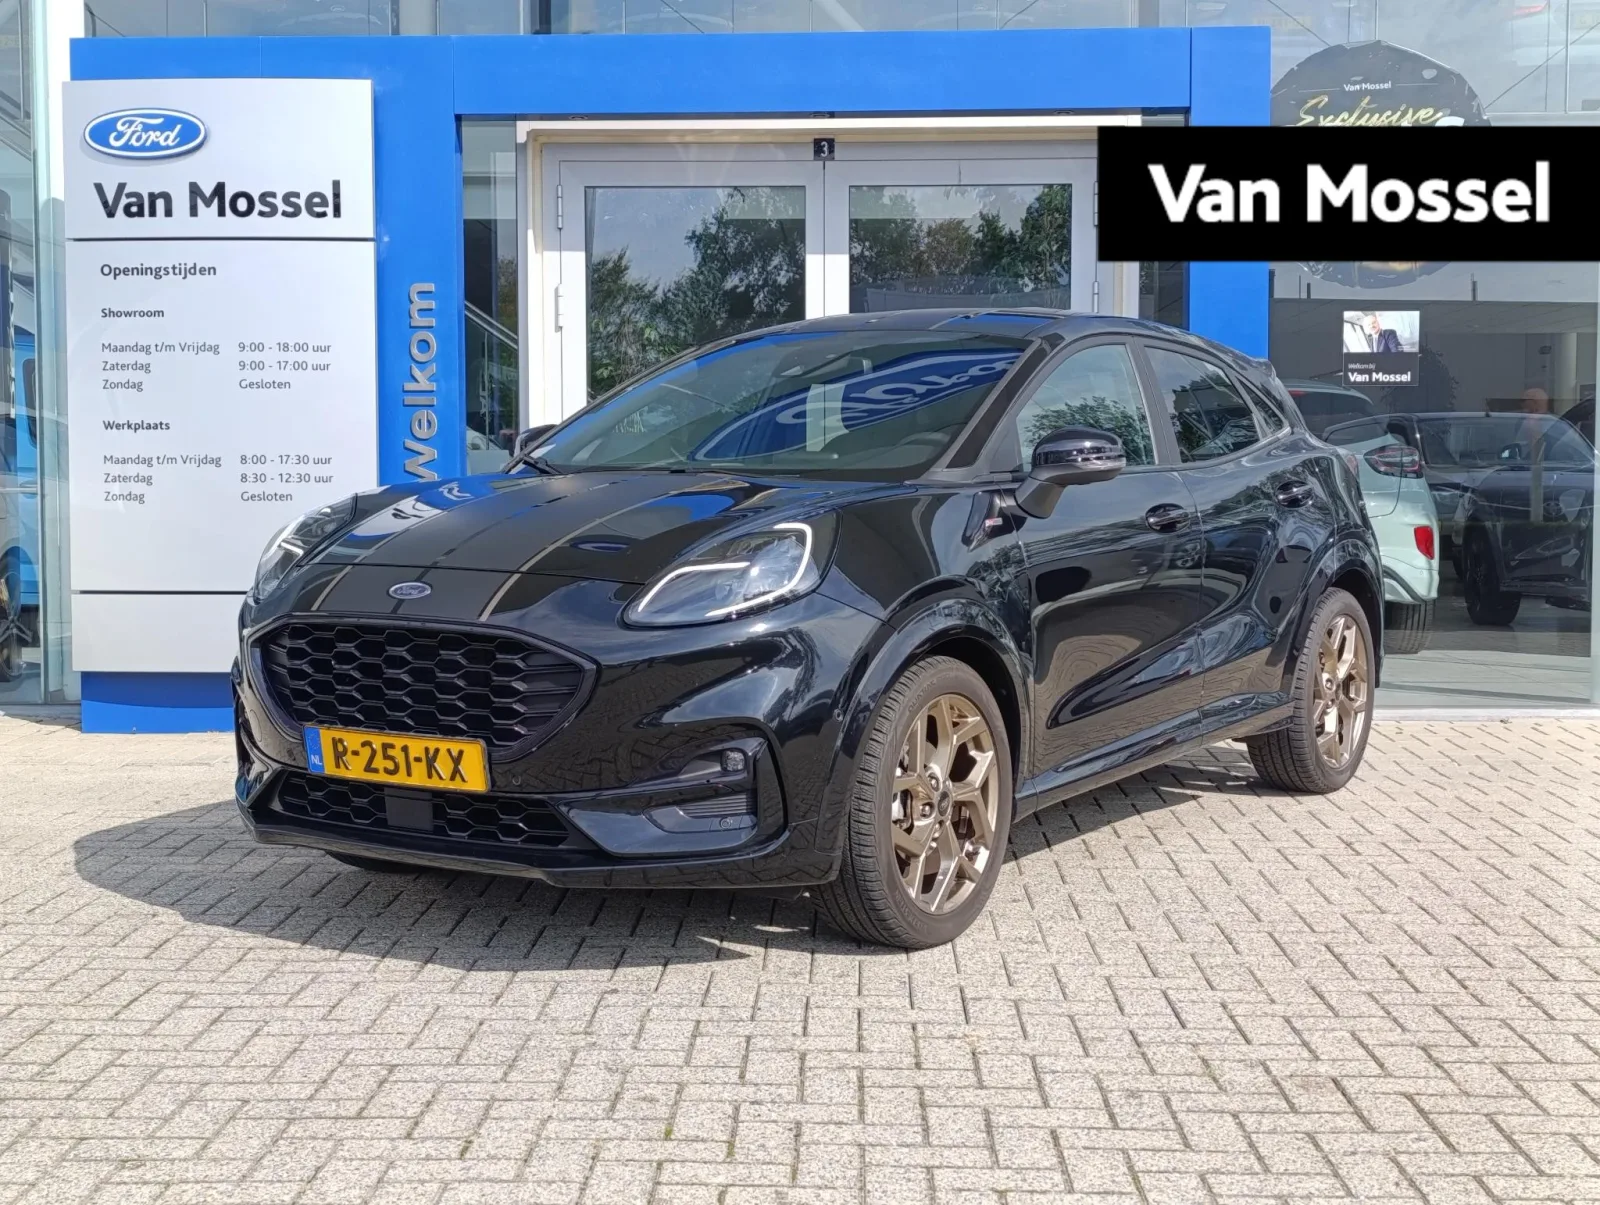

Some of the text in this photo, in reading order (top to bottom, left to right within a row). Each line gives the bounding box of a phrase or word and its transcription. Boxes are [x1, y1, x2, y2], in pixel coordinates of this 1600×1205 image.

[1343, 80, 1392, 92] Van Mossel
[108, 116, 182, 147] Ford
[819, 140, 829, 158] 3
[93, 179, 342, 219] Van Mossel
[100, 262, 217, 281] Openingstijden
[100, 307, 165, 319] Showroom
[101, 341, 152, 356] Maandag
[154, 341, 176, 353] t/m
[178, 341, 221, 356] Vrijdag
[237, 341, 265, 353] 9:00
[276, 341, 310, 353] 18:00
[312, 344, 332, 353] uur
[102, 360, 152, 374] Zaterdag
[238, 360, 265, 371] 9:00
[276, 360, 309, 371] 17:00
[311, 363, 331, 372] uur
[403, 282, 438, 482] Welkom
[1347, 371, 1412, 383] Van Mossel
[102, 378, 291, 393] Zondag Gesloten
[102, 419, 171, 434] Werkplaats
[103, 453, 154, 468] Maandag
[156, 454, 178, 465] t/m
[180, 453, 222, 468] Vrijdag
[240, 454, 267, 465] 8:00
[277, 454, 310, 465] 17:30
[312, 457, 333, 465] uur
[103, 472, 154, 487] Zaterdag
[240, 472, 267, 484] 8:30
[278, 472, 311, 484] 12:30
[313, 475, 334, 484] uur
[104, 490, 293, 505] Zondag Gesloten
[310, 753, 323, 766] NL
[331, 736, 469, 783] R-251-KX
